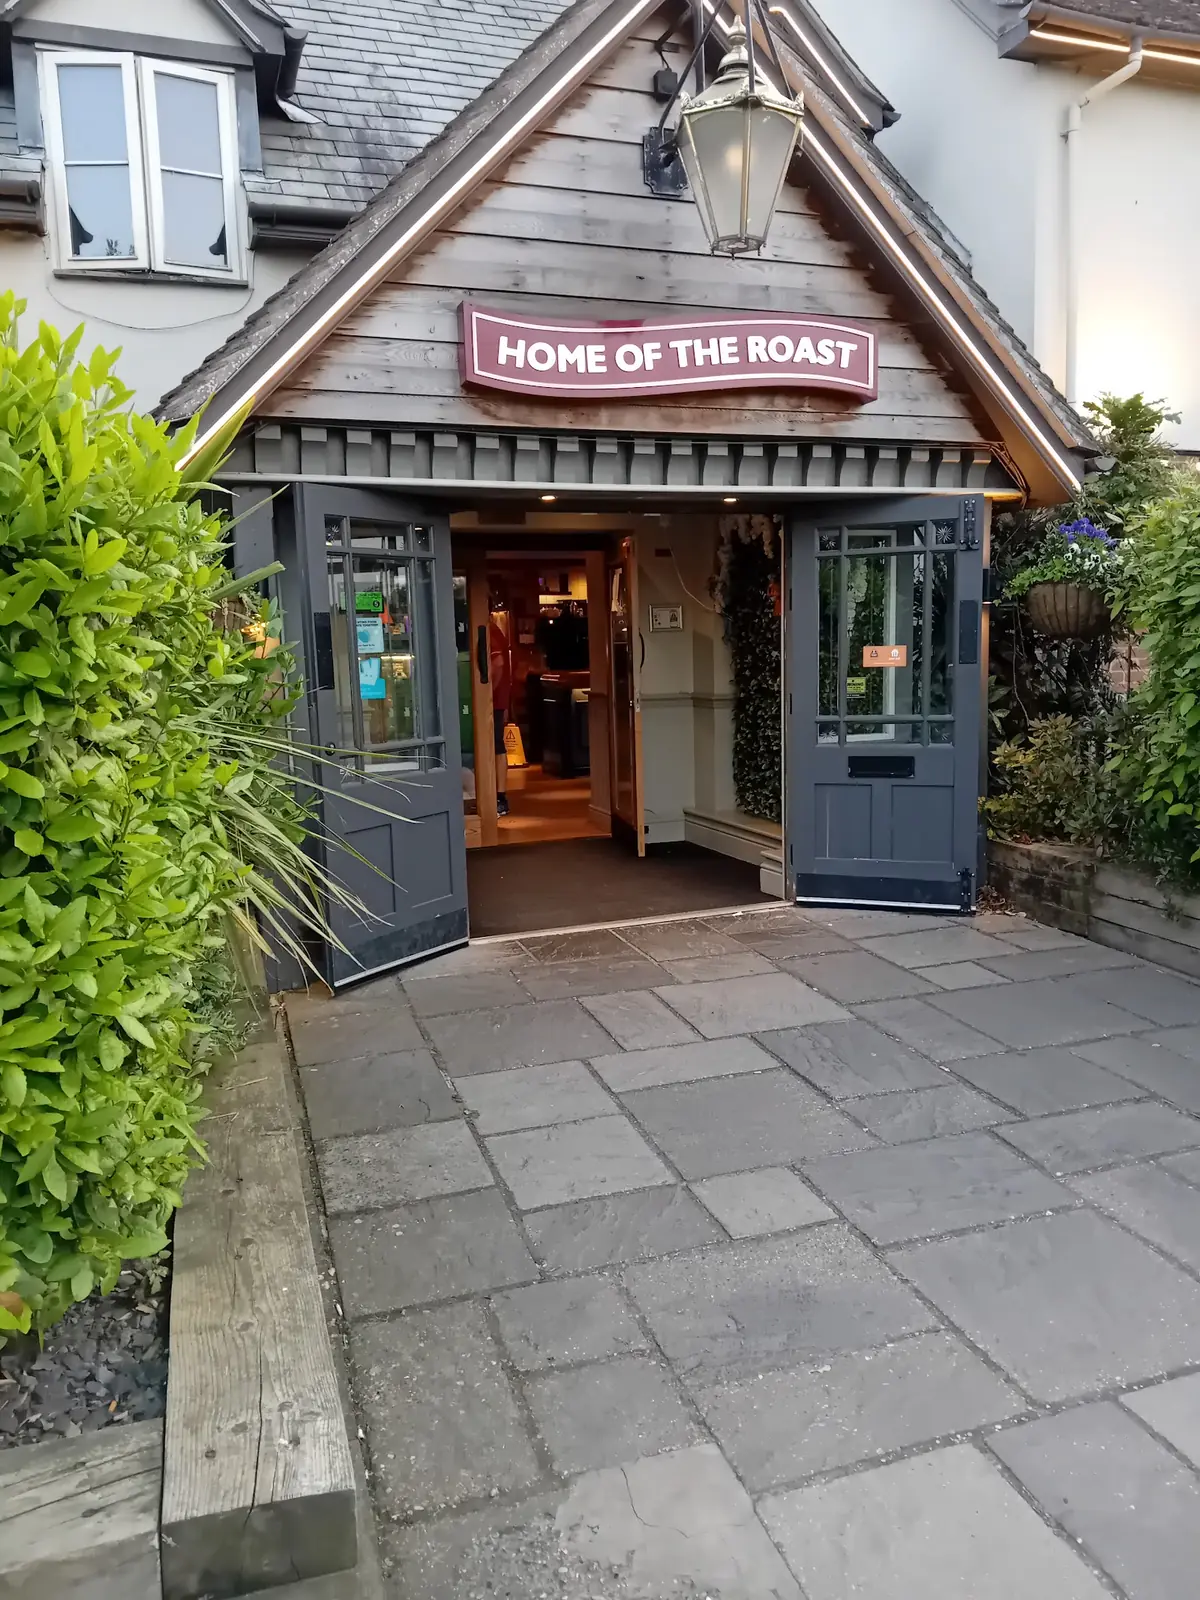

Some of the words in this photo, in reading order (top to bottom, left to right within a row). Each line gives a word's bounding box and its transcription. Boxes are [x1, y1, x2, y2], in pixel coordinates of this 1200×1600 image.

[497, 335, 607, 374] HOME
[615, 342, 663, 372] OF
[669, 336, 740, 368] THE
[747, 335, 858, 369] ROAST
